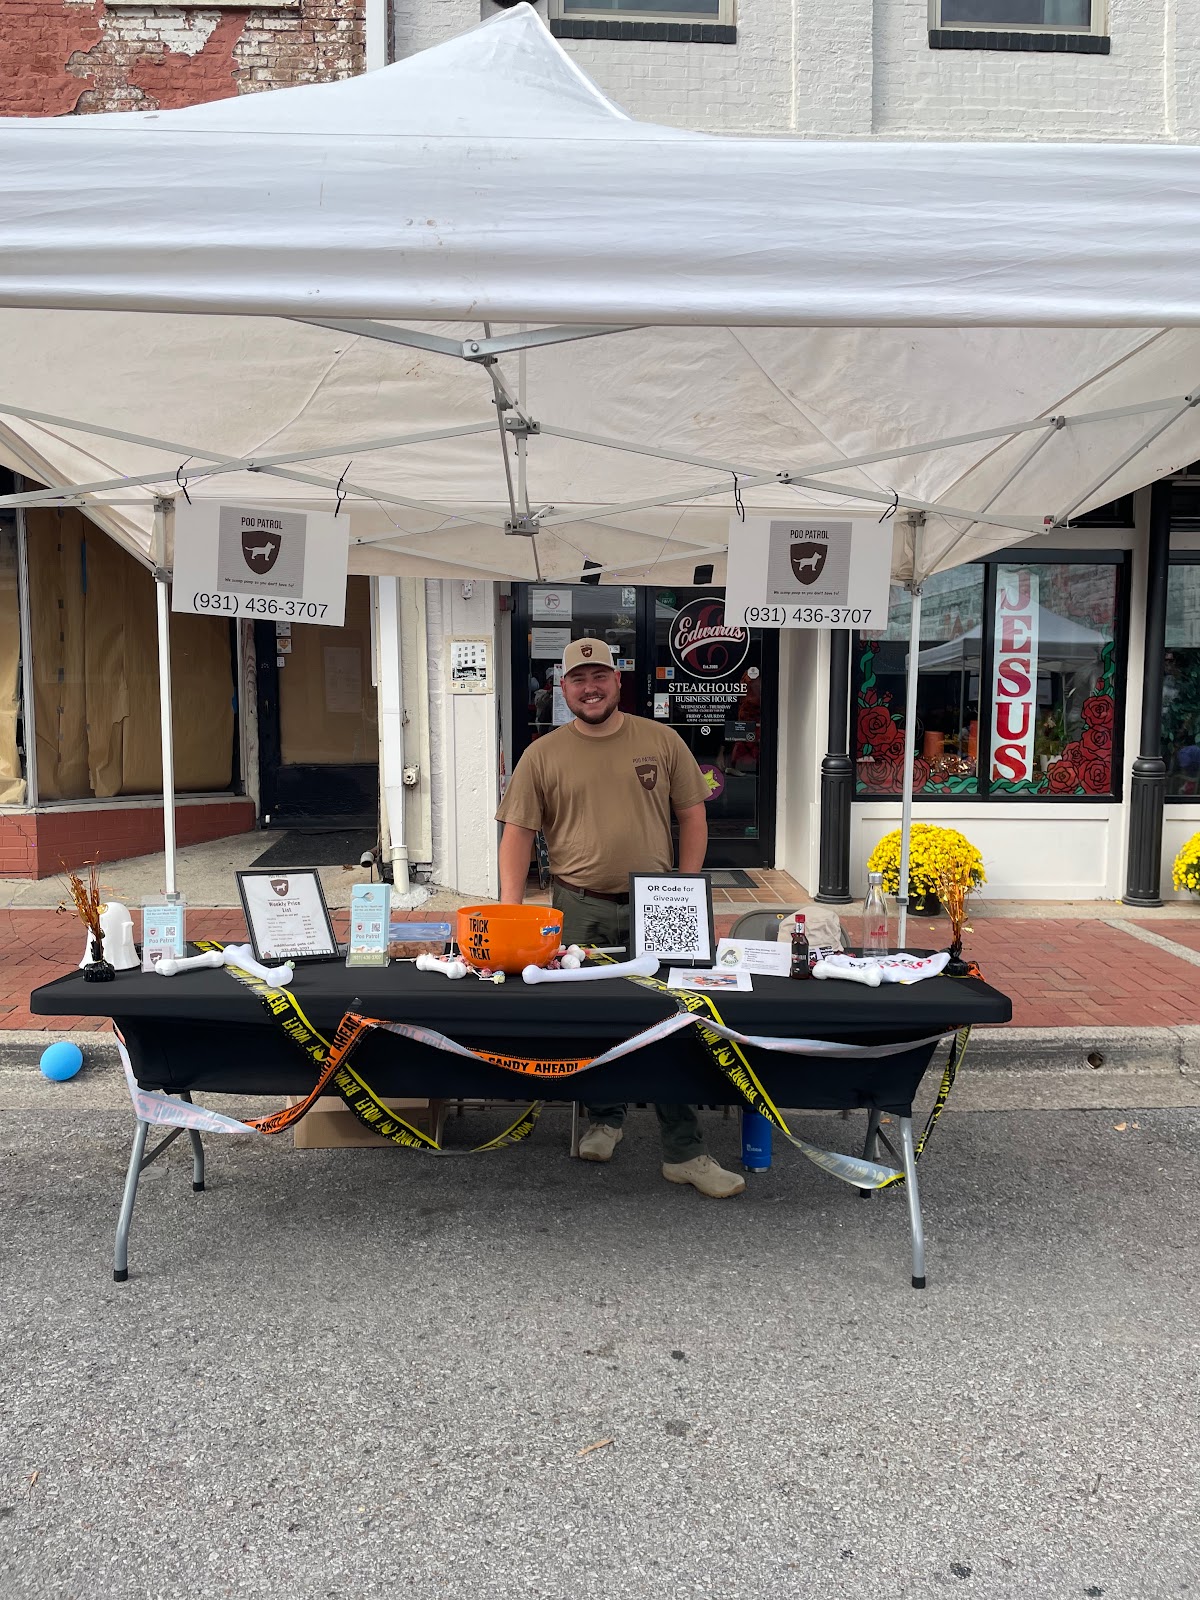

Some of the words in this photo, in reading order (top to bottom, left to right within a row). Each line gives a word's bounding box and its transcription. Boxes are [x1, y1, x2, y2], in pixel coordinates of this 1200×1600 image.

[241, 516, 256, 527] POO
[257, 518, 283, 530] PATROL
[790, 529, 804, 539] POO
[805, 530, 830, 540] PATROL
[193, 592, 239, 614] (931)
[245, 597, 328, 618] 436-3707
[744, 606, 787, 626] (931)
[792, 608, 872, 624] 436-3707
[992, 570, 1033, 783] JESUS
[668, 682, 748, 693] STEAKHOUSE
[675, 695, 711, 703] BUSINESS
[711, 695, 738, 703] HOURS
[653, 894, 689, 903] Giveaway
[469, 917, 489, 934] TRICK
[473, 933, 483, 947] OR
[469, 946, 491, 961] TREAT
[534, 1062, 579, 1074] AHEAD!
[728, 1065, 759, 1104] BEWARE
